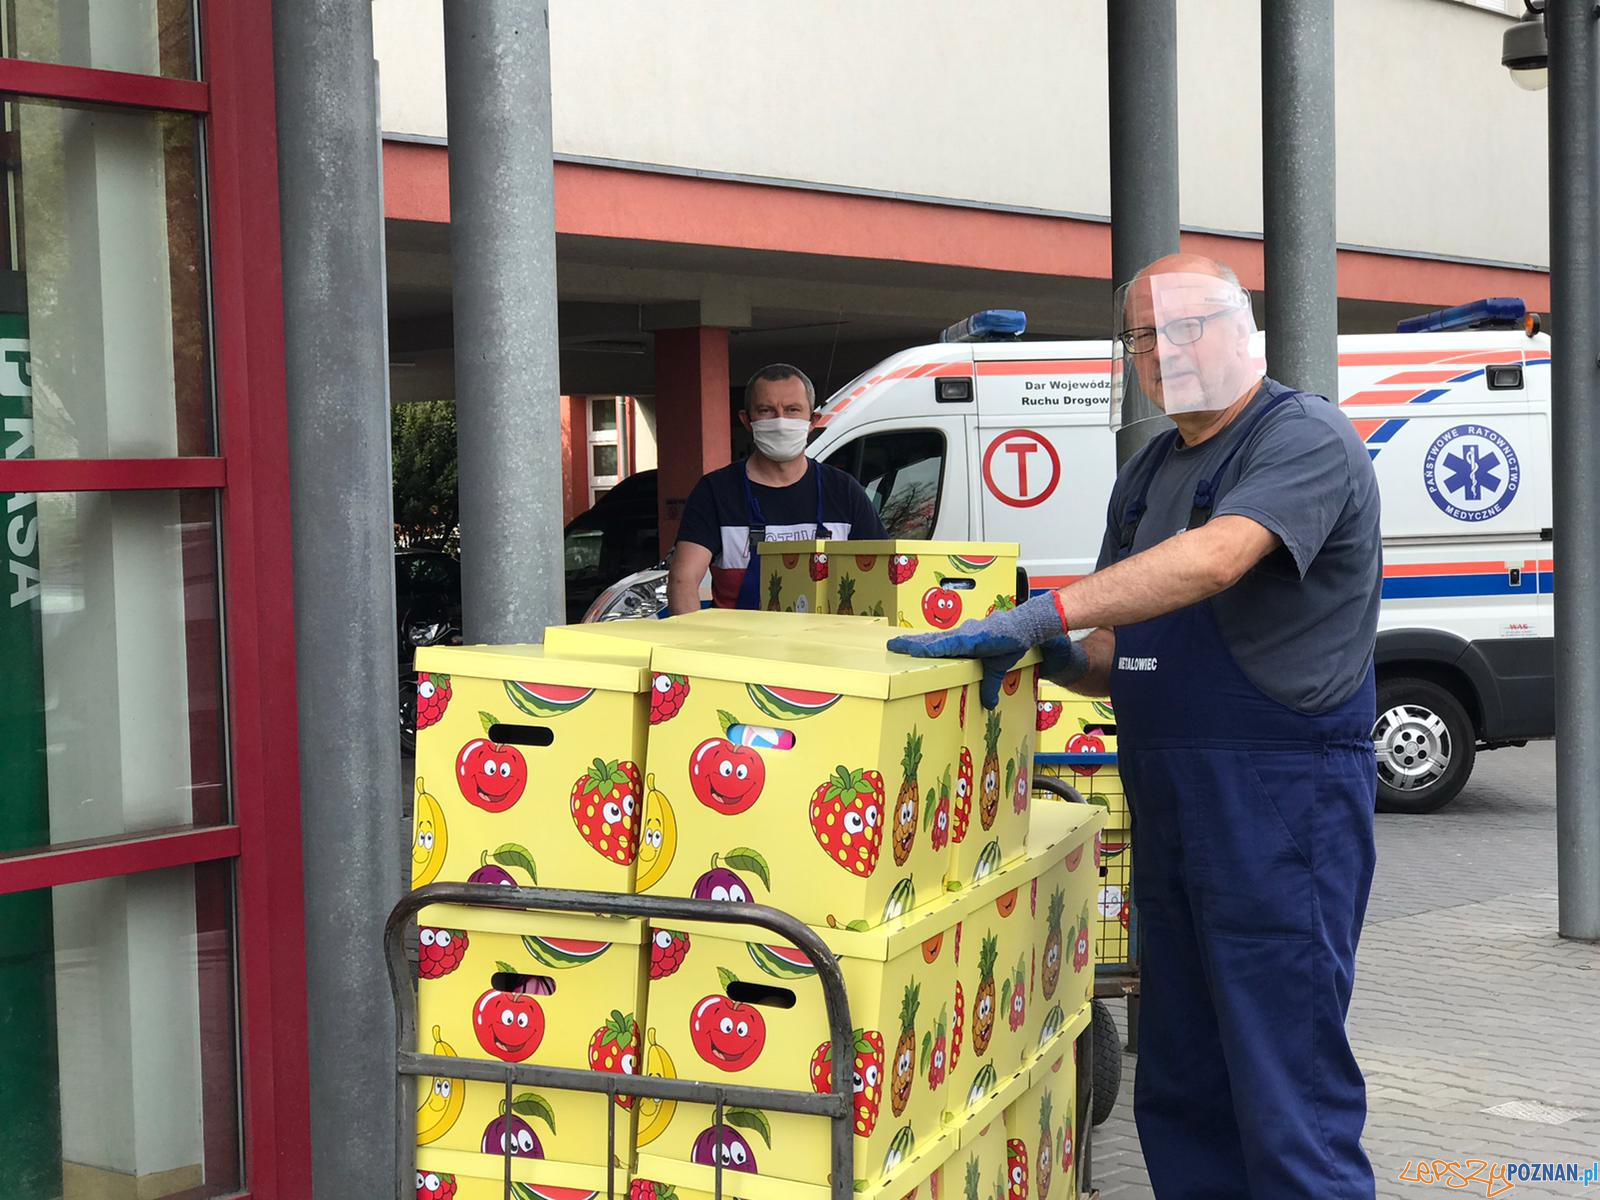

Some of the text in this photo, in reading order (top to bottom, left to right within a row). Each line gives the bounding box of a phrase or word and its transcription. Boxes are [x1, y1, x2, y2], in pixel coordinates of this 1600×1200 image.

[1025, 380, 1123, 391] Dar Wojewódz
[1021, 395, 1123, 407] Ruchu Drogow
[1468, 426, 1519, 492] RATOWNICTWO
[1005, 443, 1038, 497] T
[1444, 503, 1502, 520] MEDYCZNE
